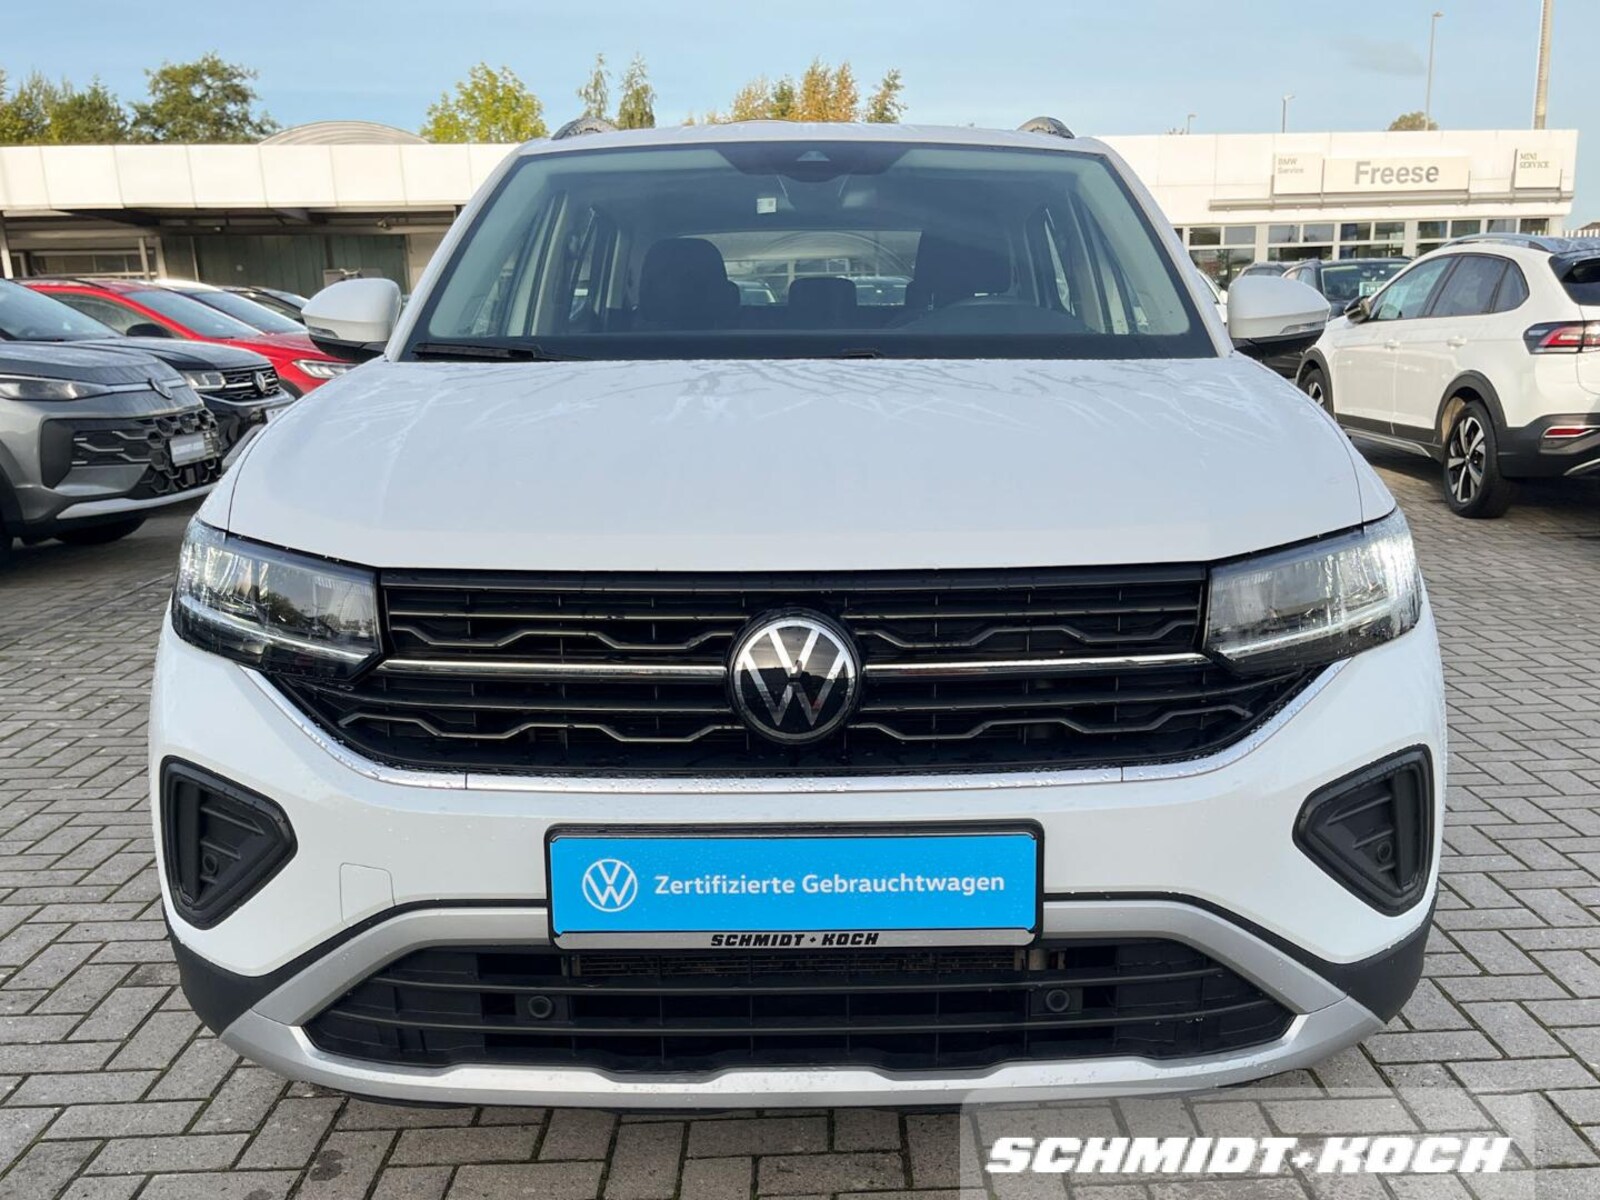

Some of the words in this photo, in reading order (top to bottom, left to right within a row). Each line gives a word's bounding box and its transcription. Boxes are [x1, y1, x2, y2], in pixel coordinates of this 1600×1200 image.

[1354, 160, 1440, 185] Freese
[654, 874, 796, 895] Zertifizierte
[801, 872, 1005, 896] Gebrauchtwagen
[711, 934, 805, 946] SCHMIDT
[821, 932, 879, 946] KOCH
